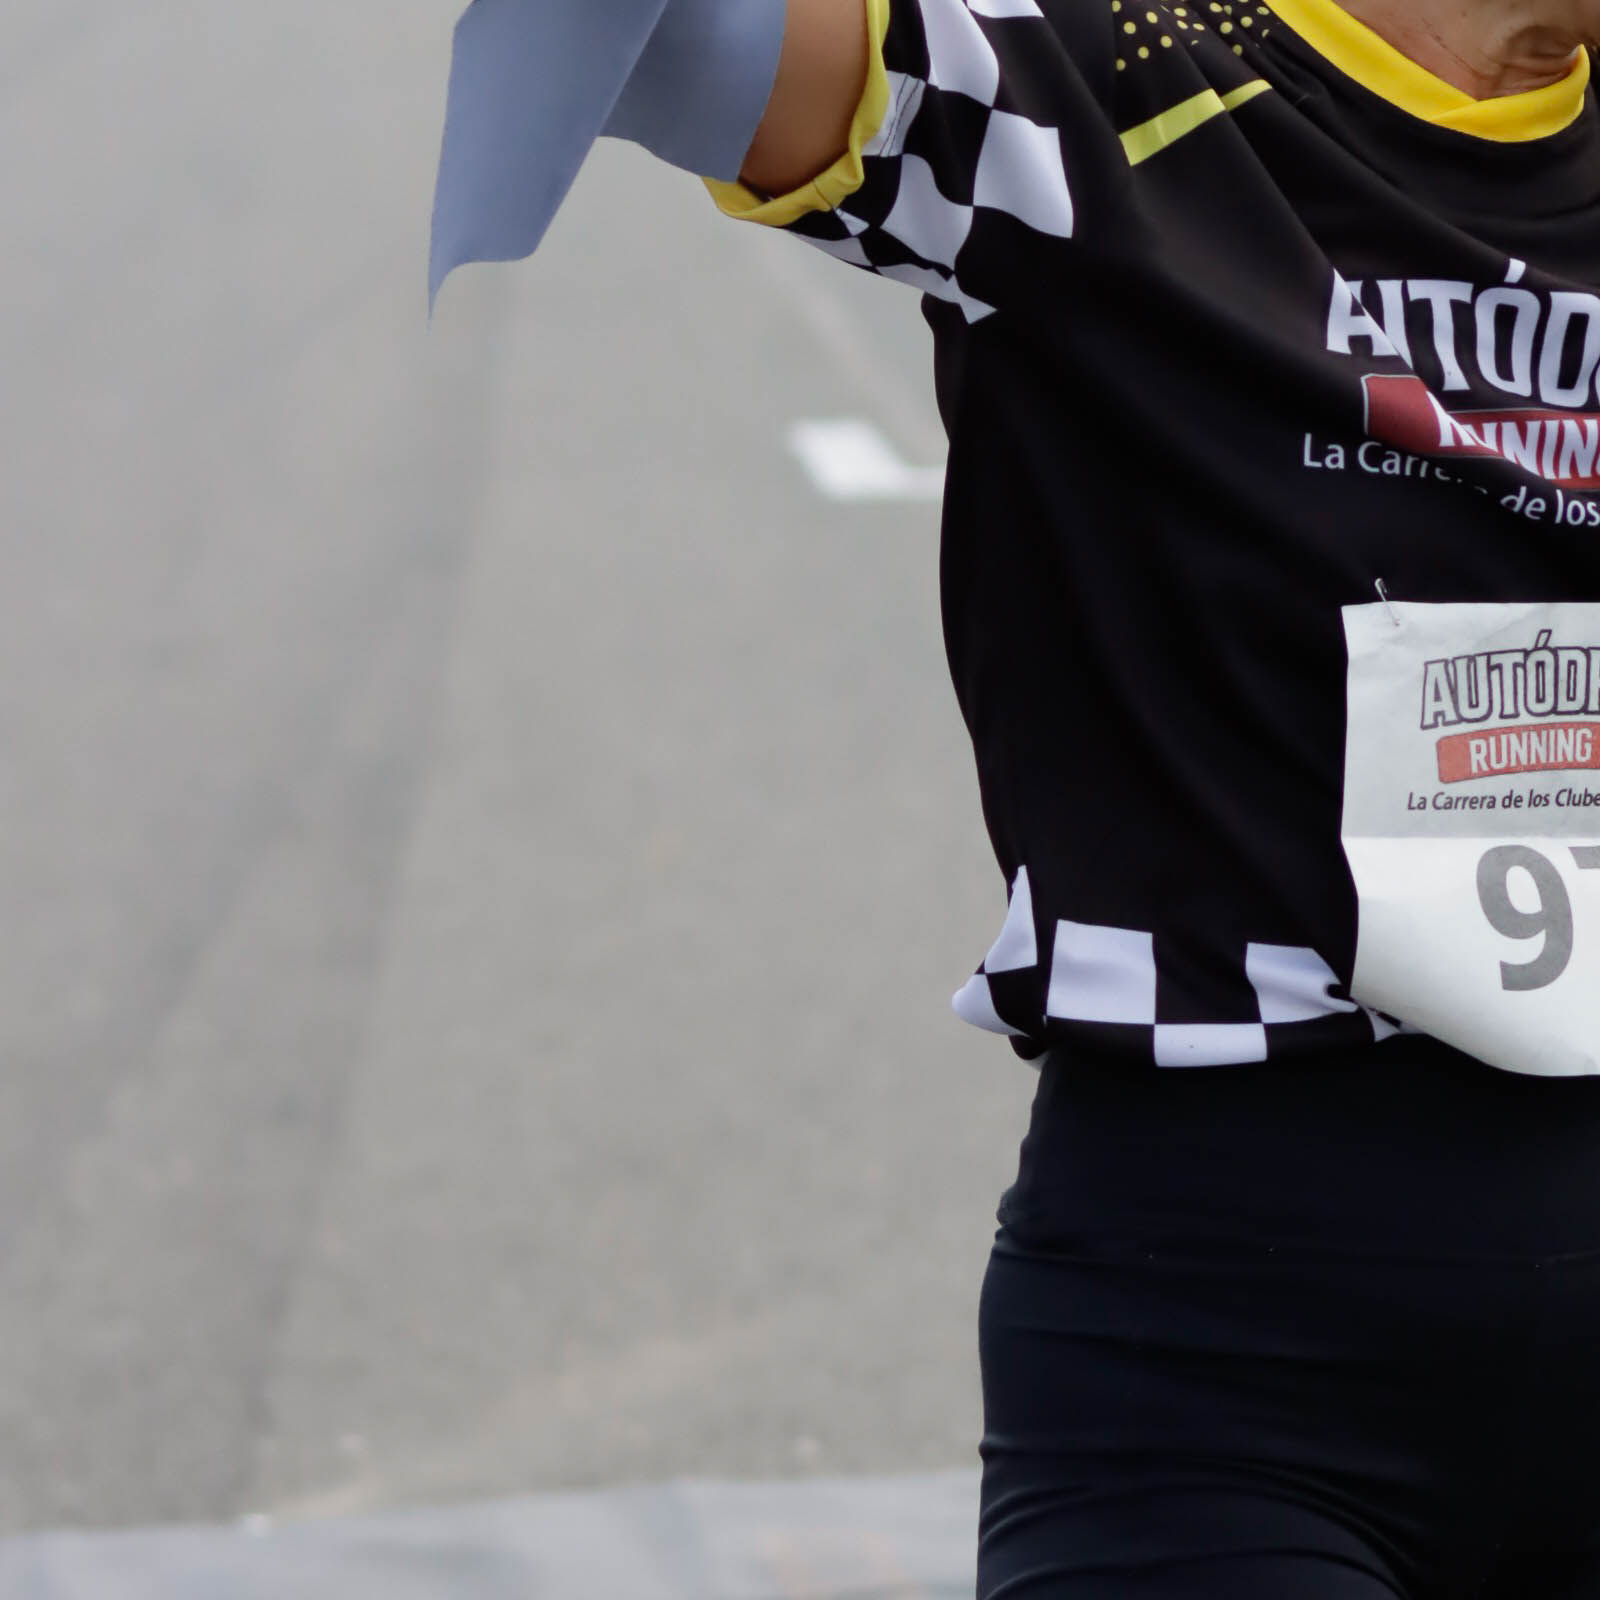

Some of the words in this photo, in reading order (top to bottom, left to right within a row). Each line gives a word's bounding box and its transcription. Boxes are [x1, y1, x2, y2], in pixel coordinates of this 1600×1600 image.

[1303, 432, 1345, 470] La
[1500, 485, 1547, 520] de
[1468, 726, 1593, 775] RUNNING
[1407, 791, 1427, 811] La
[1432, 791, 1496, 811] Carrera
[1501, 789, 1524, 810] de
[1527, 789, 1550, 809] los
